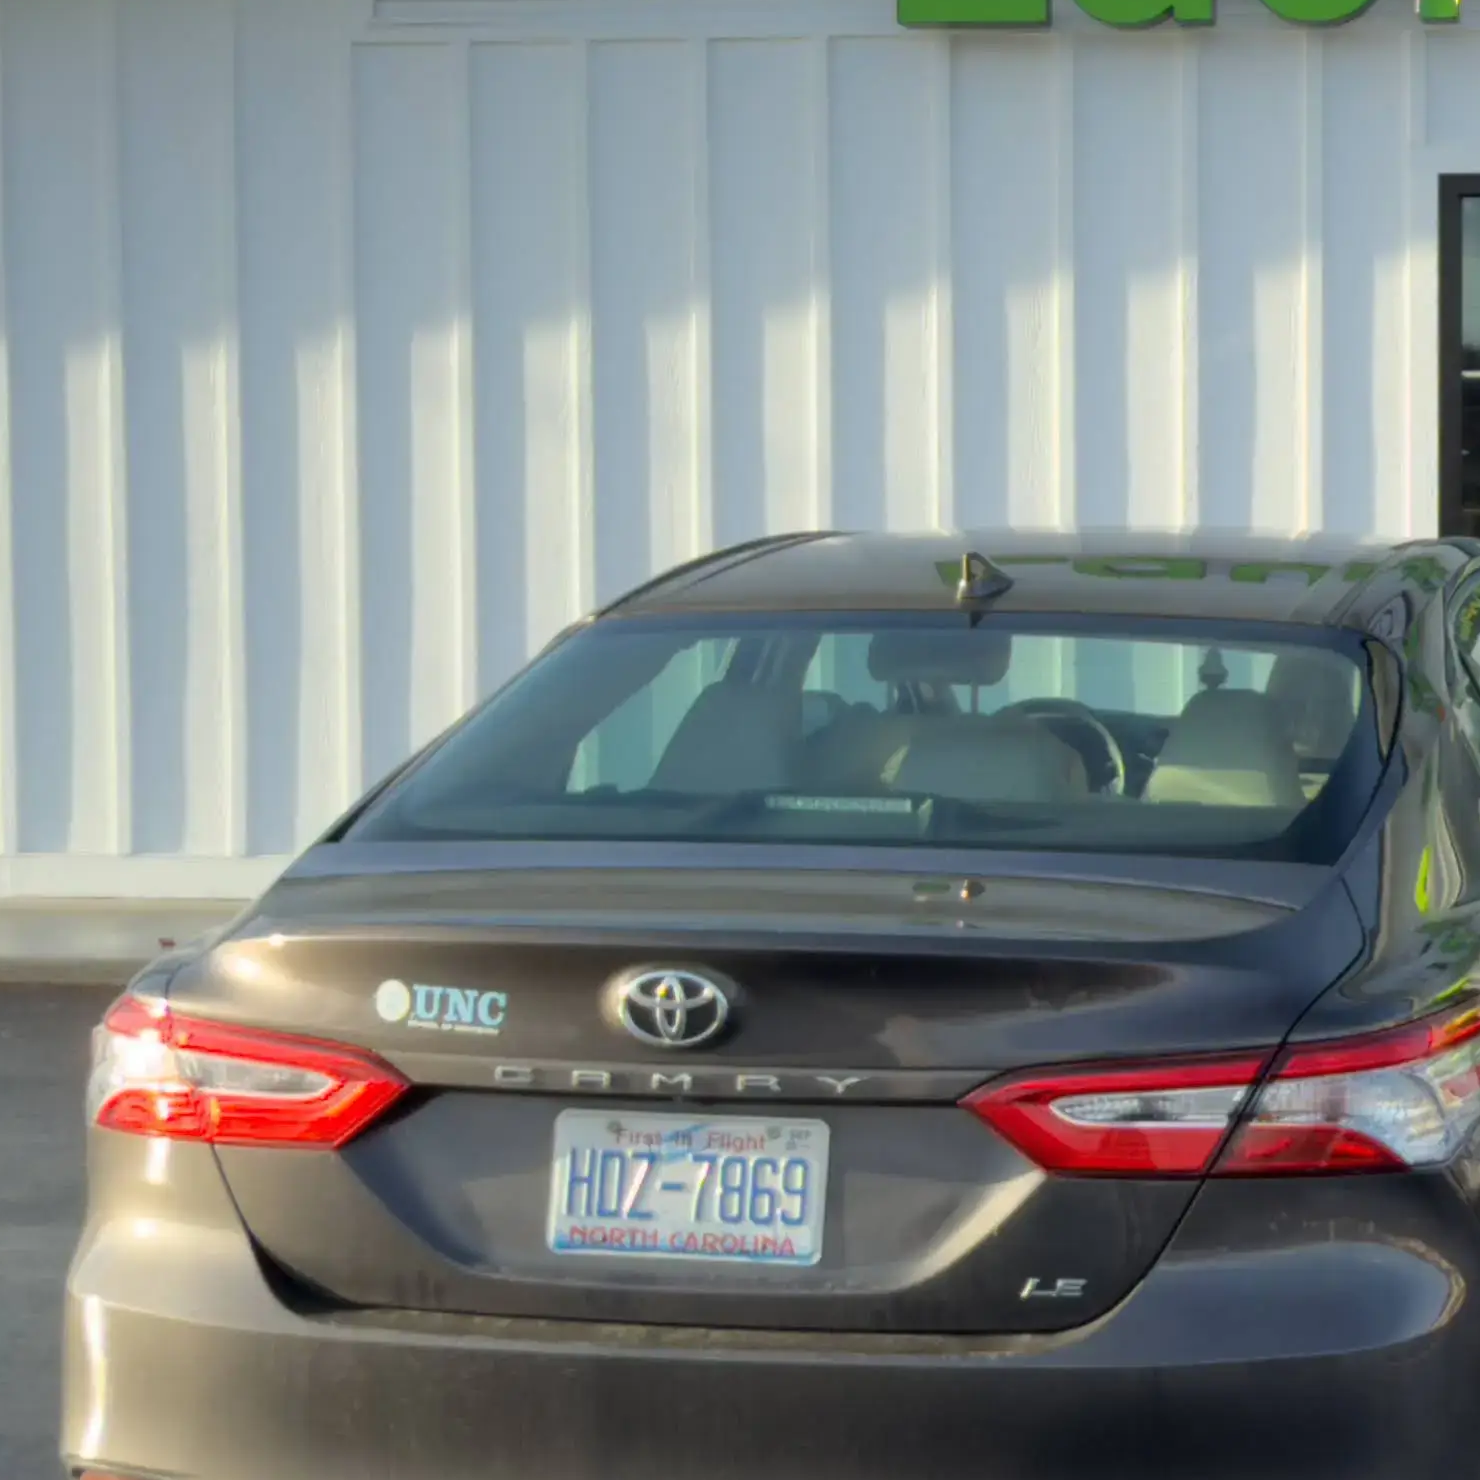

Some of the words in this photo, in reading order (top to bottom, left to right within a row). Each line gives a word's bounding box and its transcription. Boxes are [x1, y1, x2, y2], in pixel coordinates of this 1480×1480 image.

[413, 983, 508, 1027] UNC
[494, 1065, 868, 1094] CAMRY
[707, 1132, 767, 1152] Flight
[566, 1148, 810, 1226] HDZ-7869
[569, 1225, 661, 1249] NORTH
[669, 1232, 797, 1257] CAROLINA
[1019, 1277, 1088, 1301] LE
